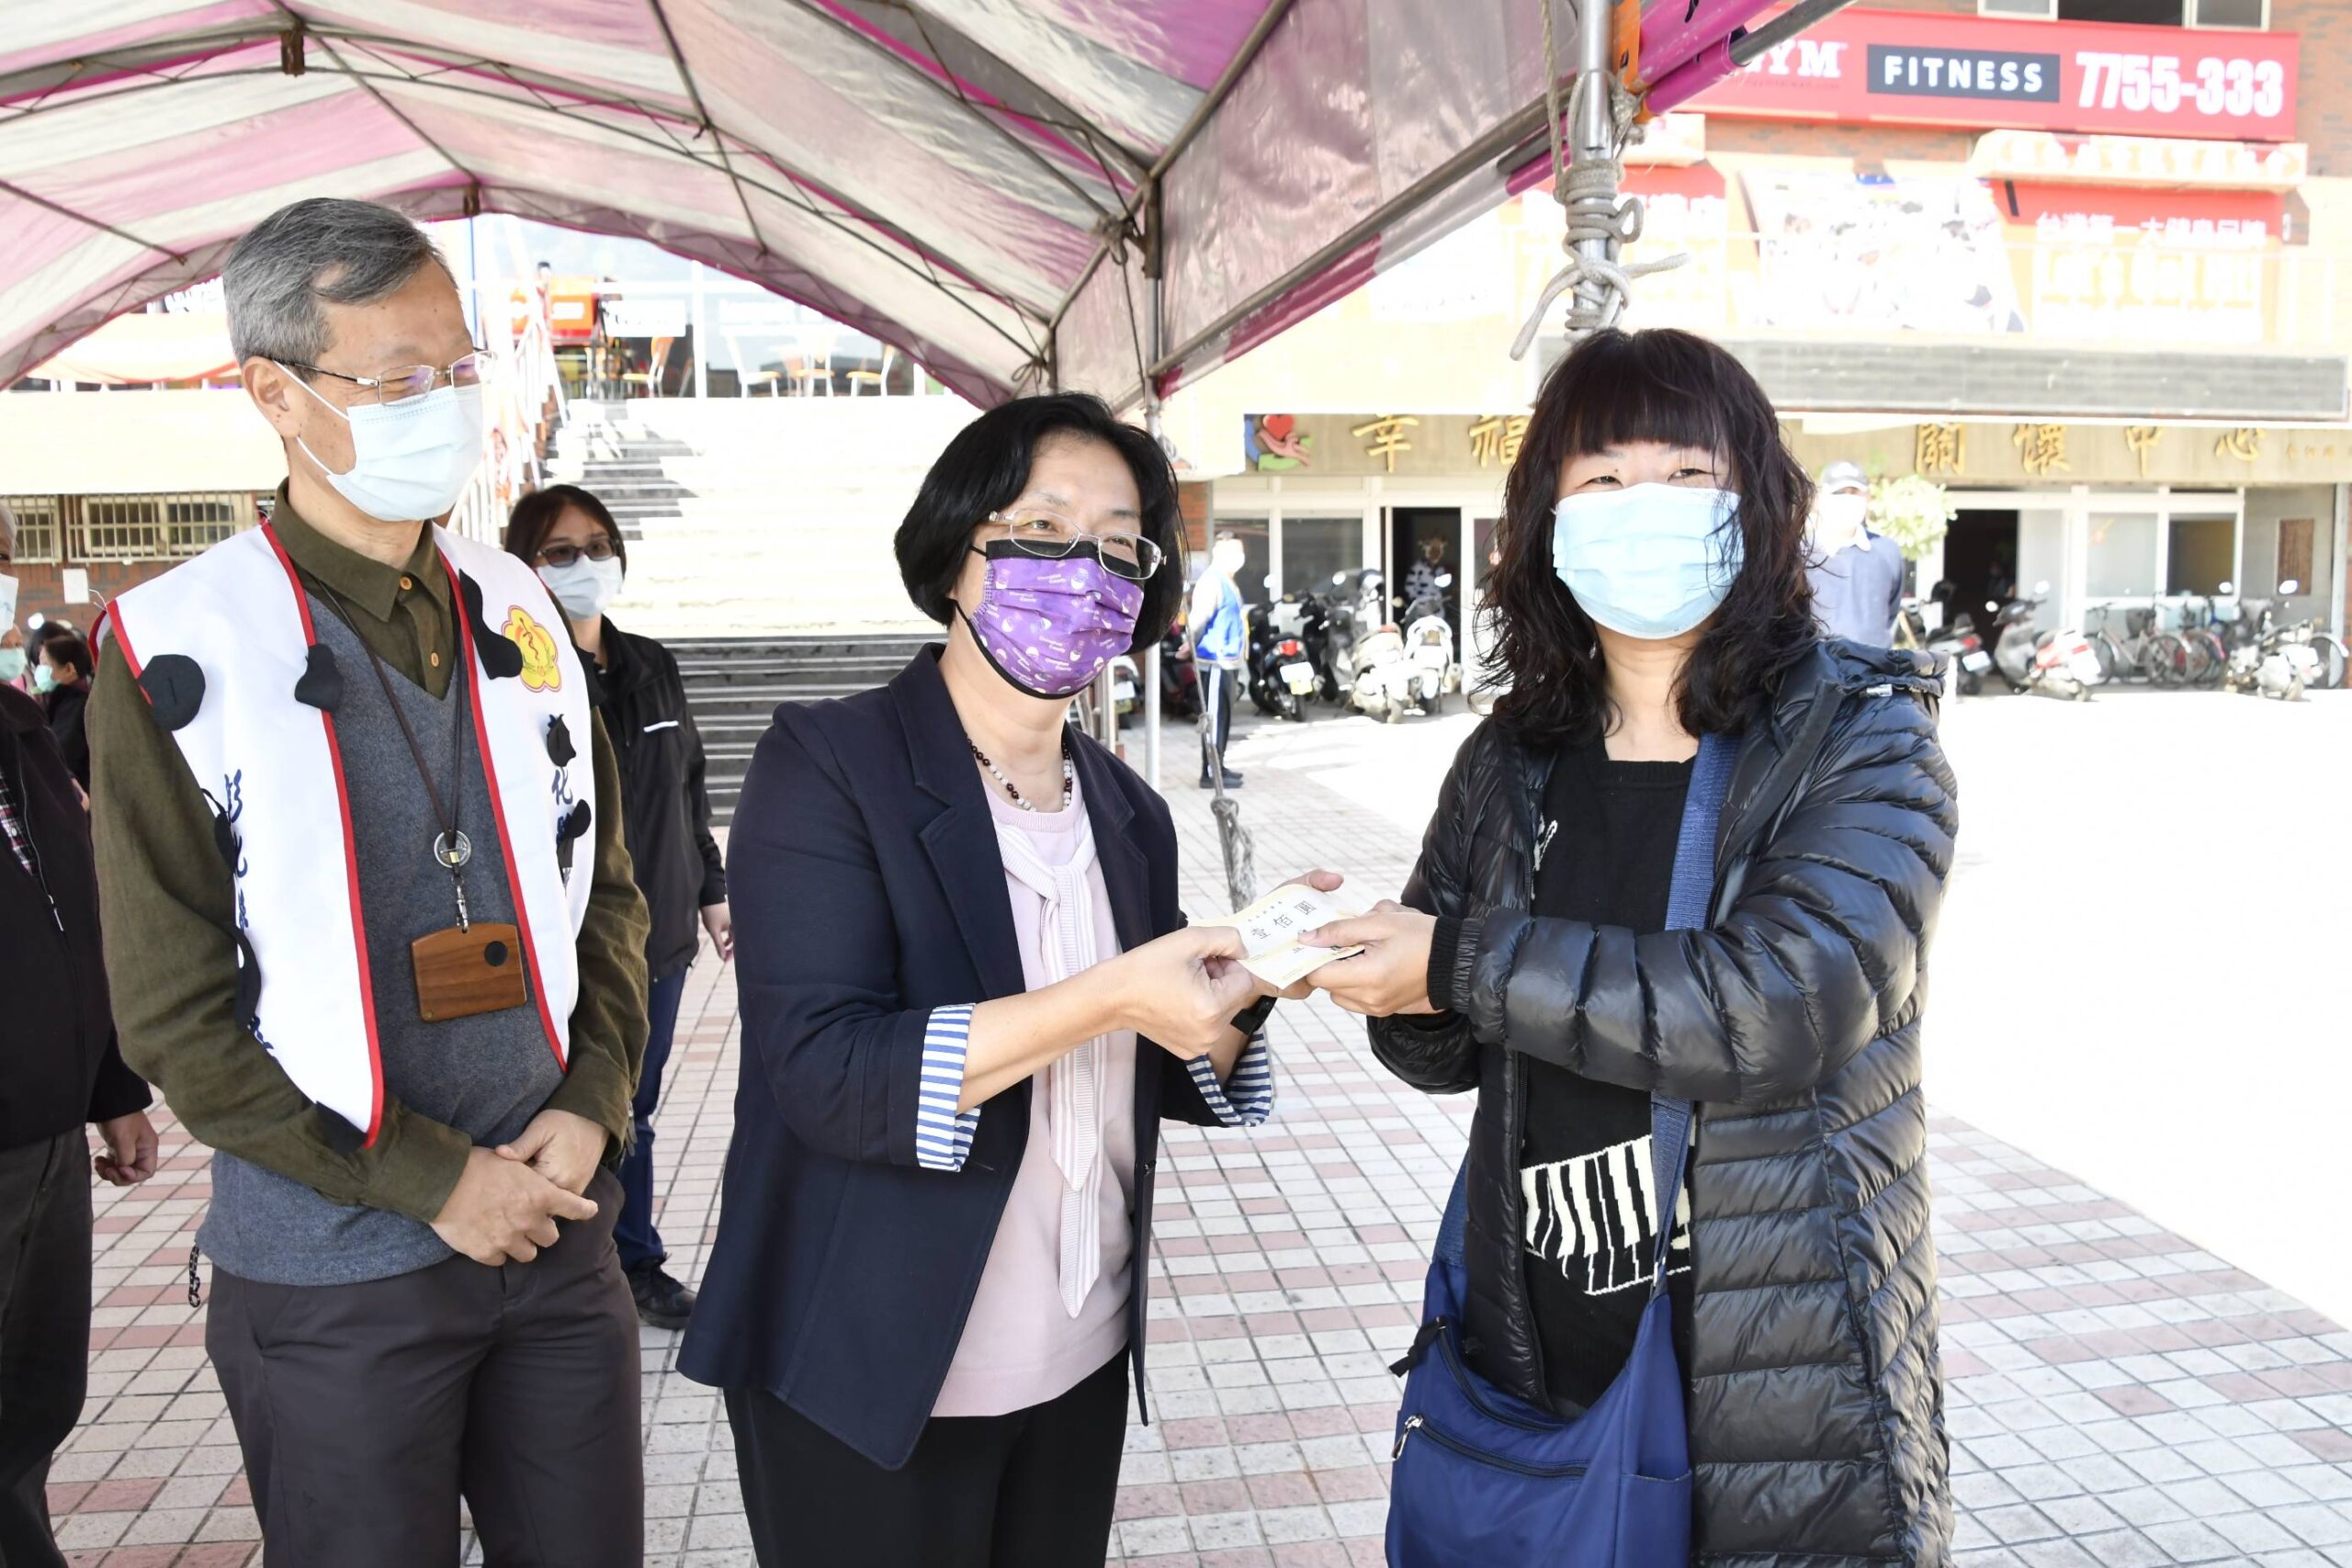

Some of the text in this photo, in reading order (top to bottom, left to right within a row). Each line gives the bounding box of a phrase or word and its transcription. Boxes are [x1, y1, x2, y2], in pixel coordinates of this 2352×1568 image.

[1883, 55, 2043, 93] FITNESS
[2076, 51, 2284, 117] 7755-333
[1915, 422, 2267, 477] 關懷中心
